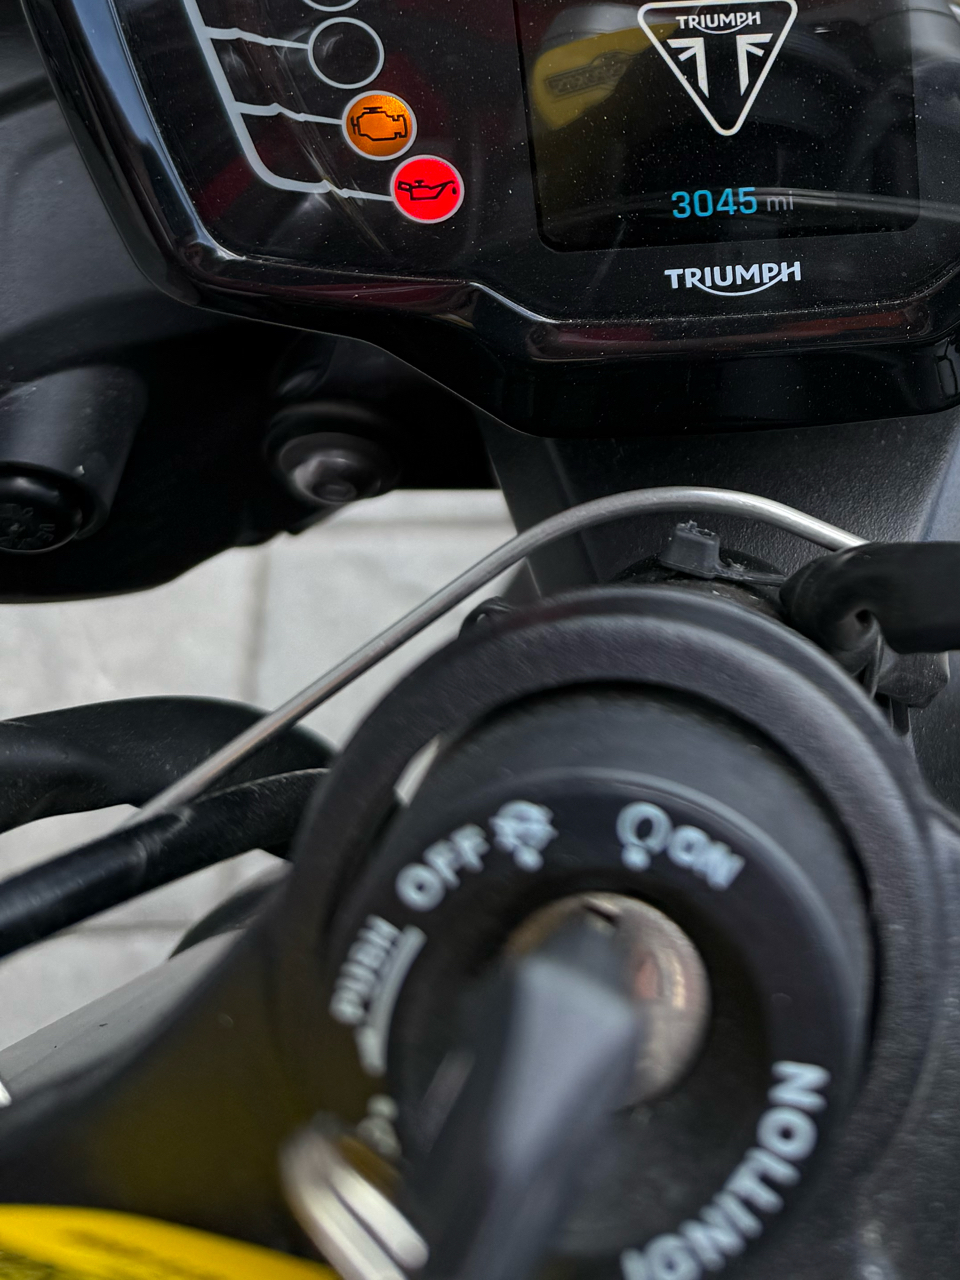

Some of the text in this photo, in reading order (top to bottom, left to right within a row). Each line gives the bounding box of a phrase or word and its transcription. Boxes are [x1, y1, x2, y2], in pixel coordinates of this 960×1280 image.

[675, 11, 761, 35] TRIUMPH
[671, 187, 794, 219] 3045 mi
[664, 261, 802, 297] TRIUMPH
[395, 823, 490, 912] OFF
[667, 824, 746, 892] ON
